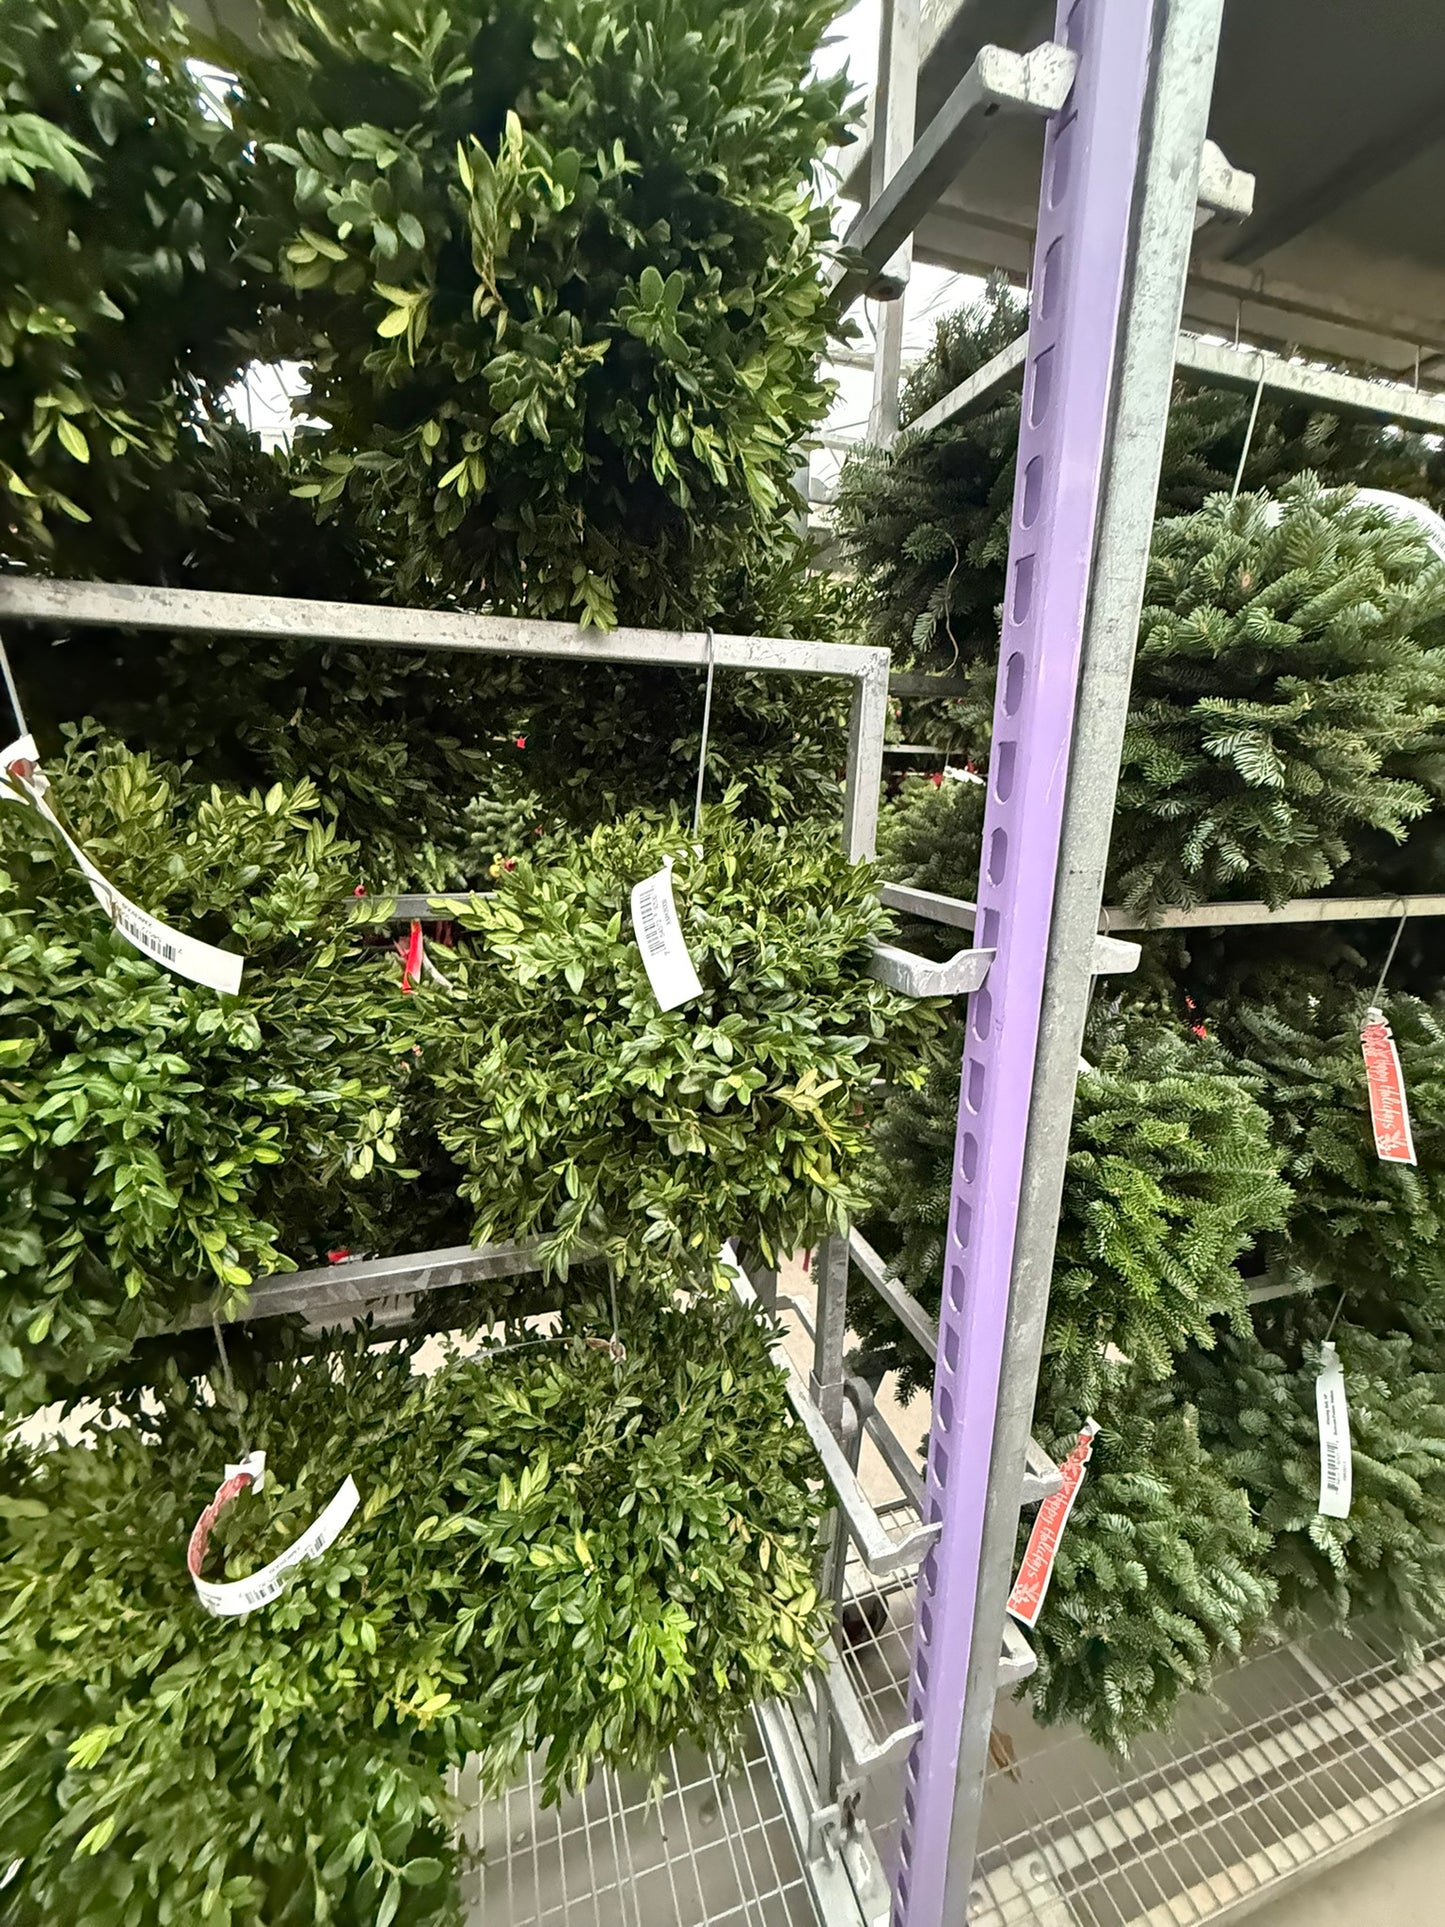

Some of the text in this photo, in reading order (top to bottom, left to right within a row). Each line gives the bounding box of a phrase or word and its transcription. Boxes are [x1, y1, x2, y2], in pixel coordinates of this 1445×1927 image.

[1369, 1059, 1401, 1129] Happy Holidays
[1025, 1491, 1068, 1578] Happy Holidays
